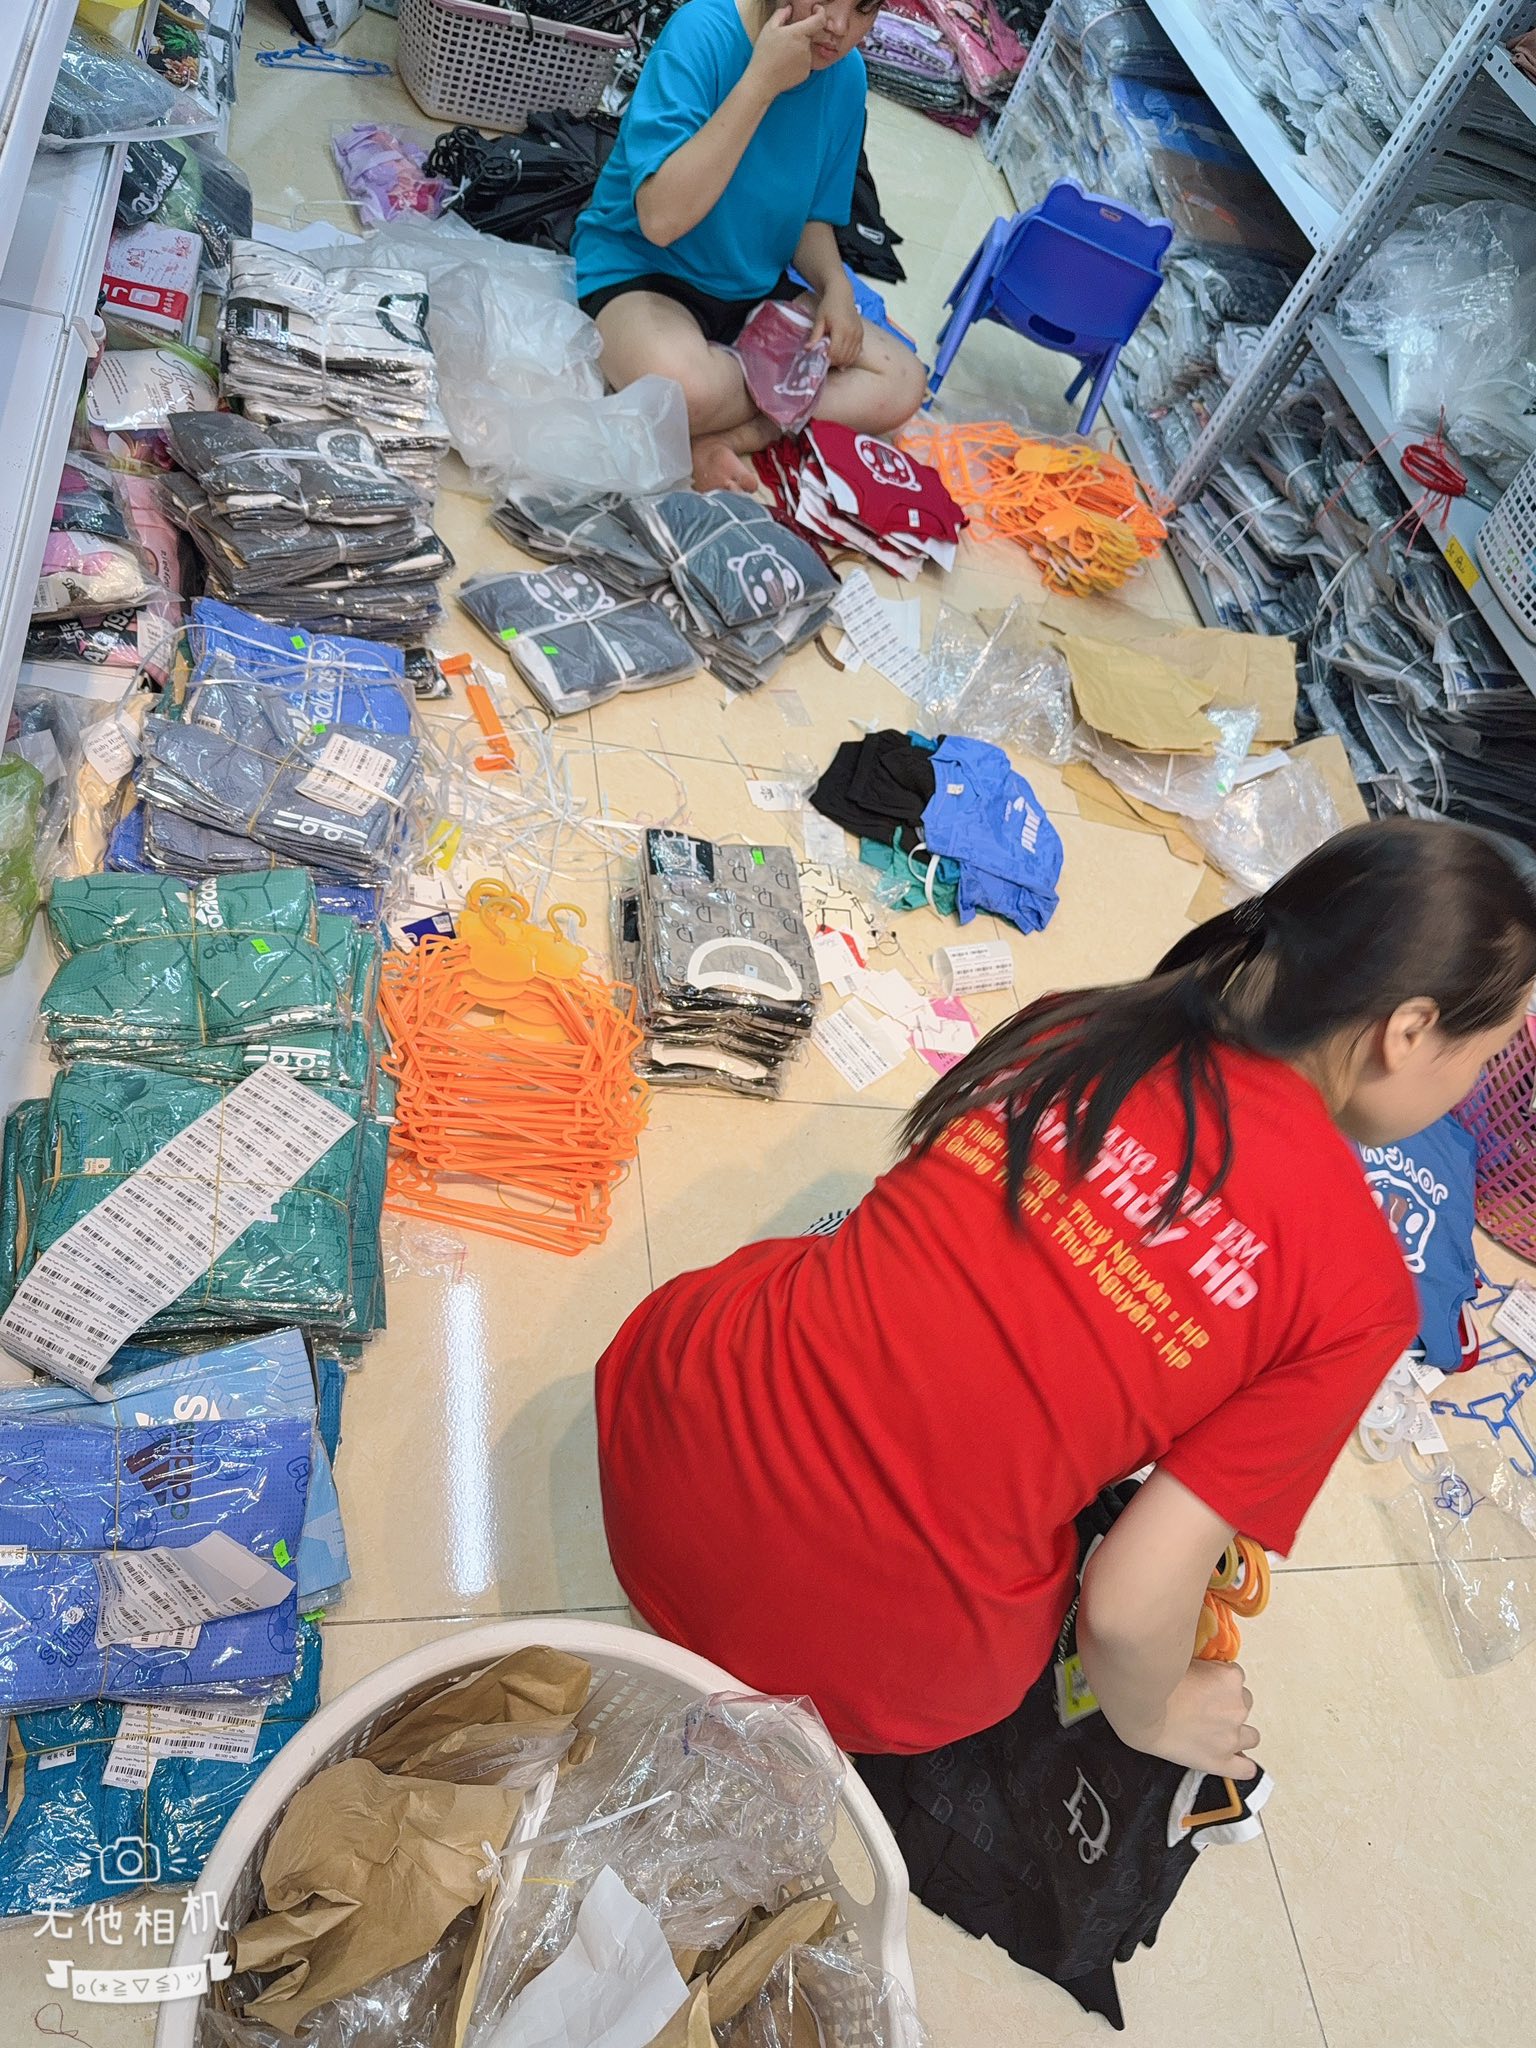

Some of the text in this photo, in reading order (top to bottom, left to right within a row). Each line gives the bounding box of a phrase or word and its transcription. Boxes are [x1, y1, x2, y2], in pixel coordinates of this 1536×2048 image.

[1187, 1244, 1258, 1310] HP
[1175, 1317, 1210, 1350] HP
[1157, 1337, 1192, 1370] HP
